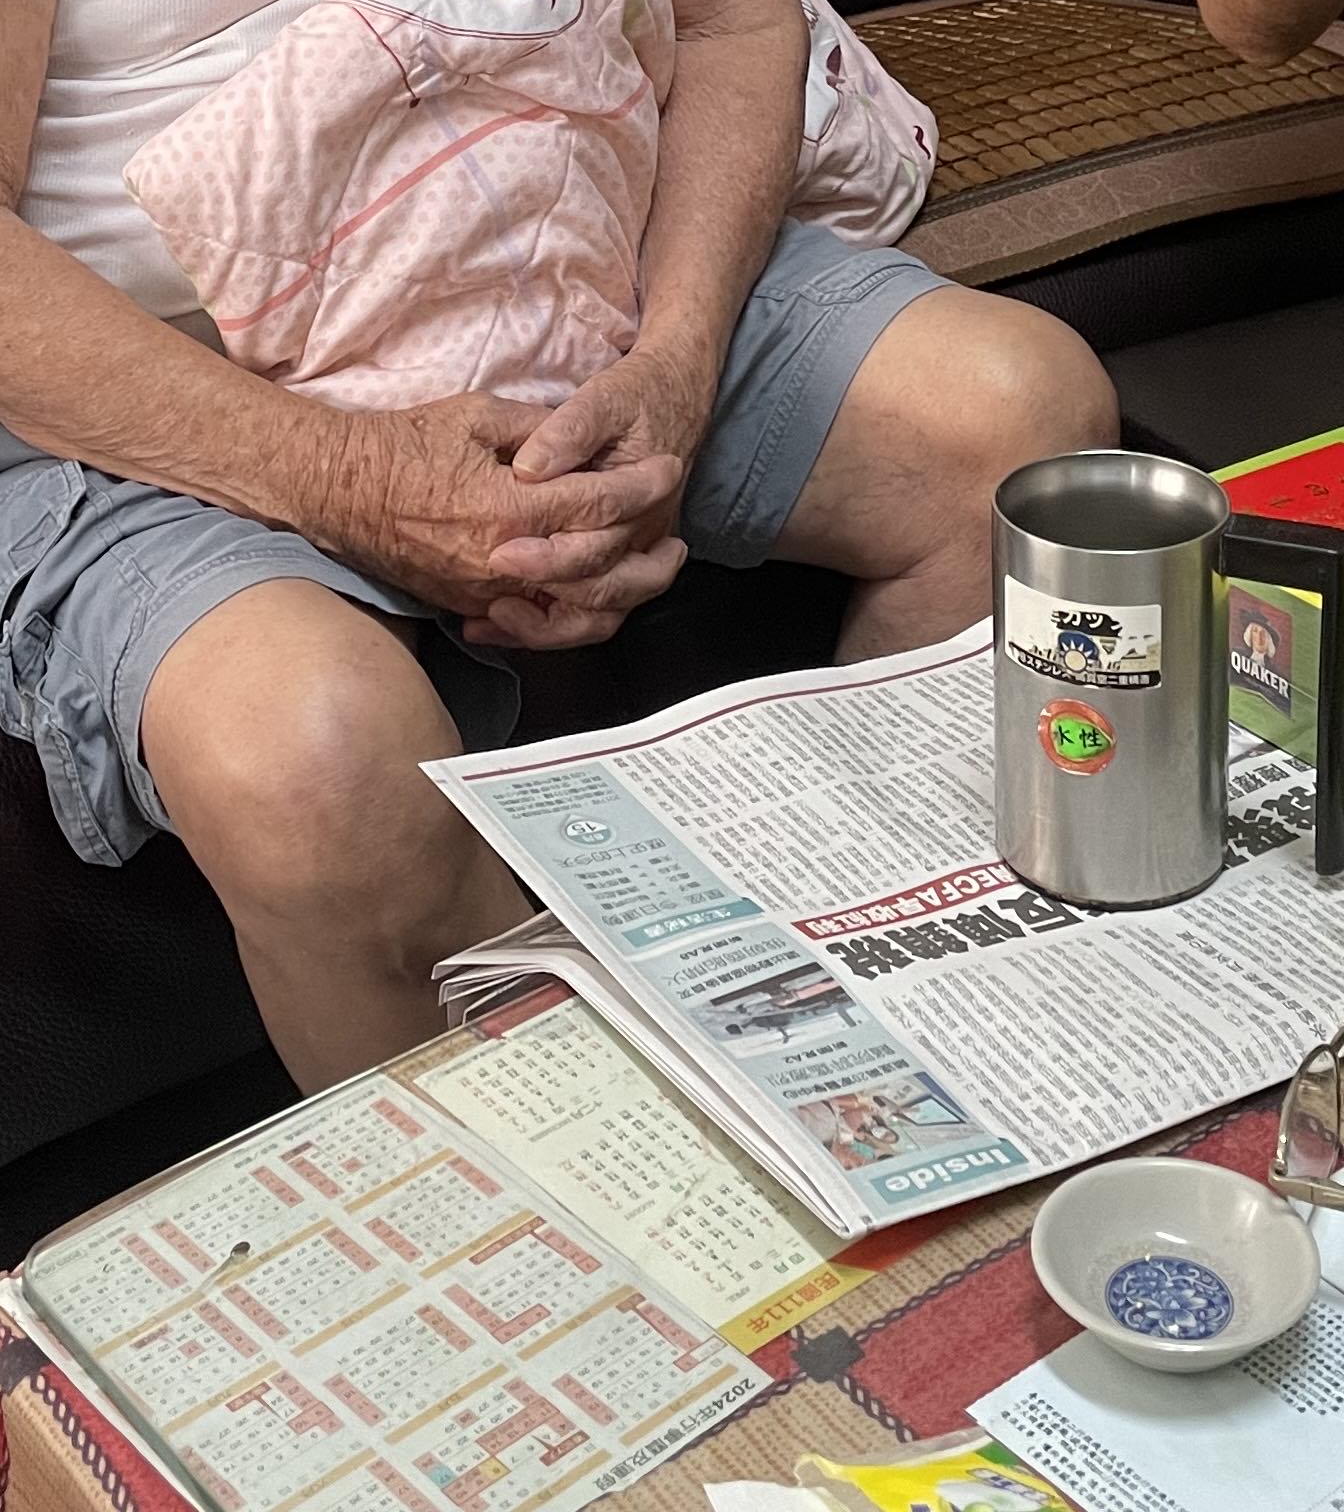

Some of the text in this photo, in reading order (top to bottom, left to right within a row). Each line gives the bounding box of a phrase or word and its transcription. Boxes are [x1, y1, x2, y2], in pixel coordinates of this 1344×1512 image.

[1230, 649, 1291, 699] QUAKER
[571, 820, 597, 833] 15
[825, 893, 1103, 980] 反傾銷稅
[885, 1148, 1009, 1194] Inside
[745, 1271, 841, 1334] 民國111年
[593, 1376, 756, 1493] 2024年行事曆及連假
